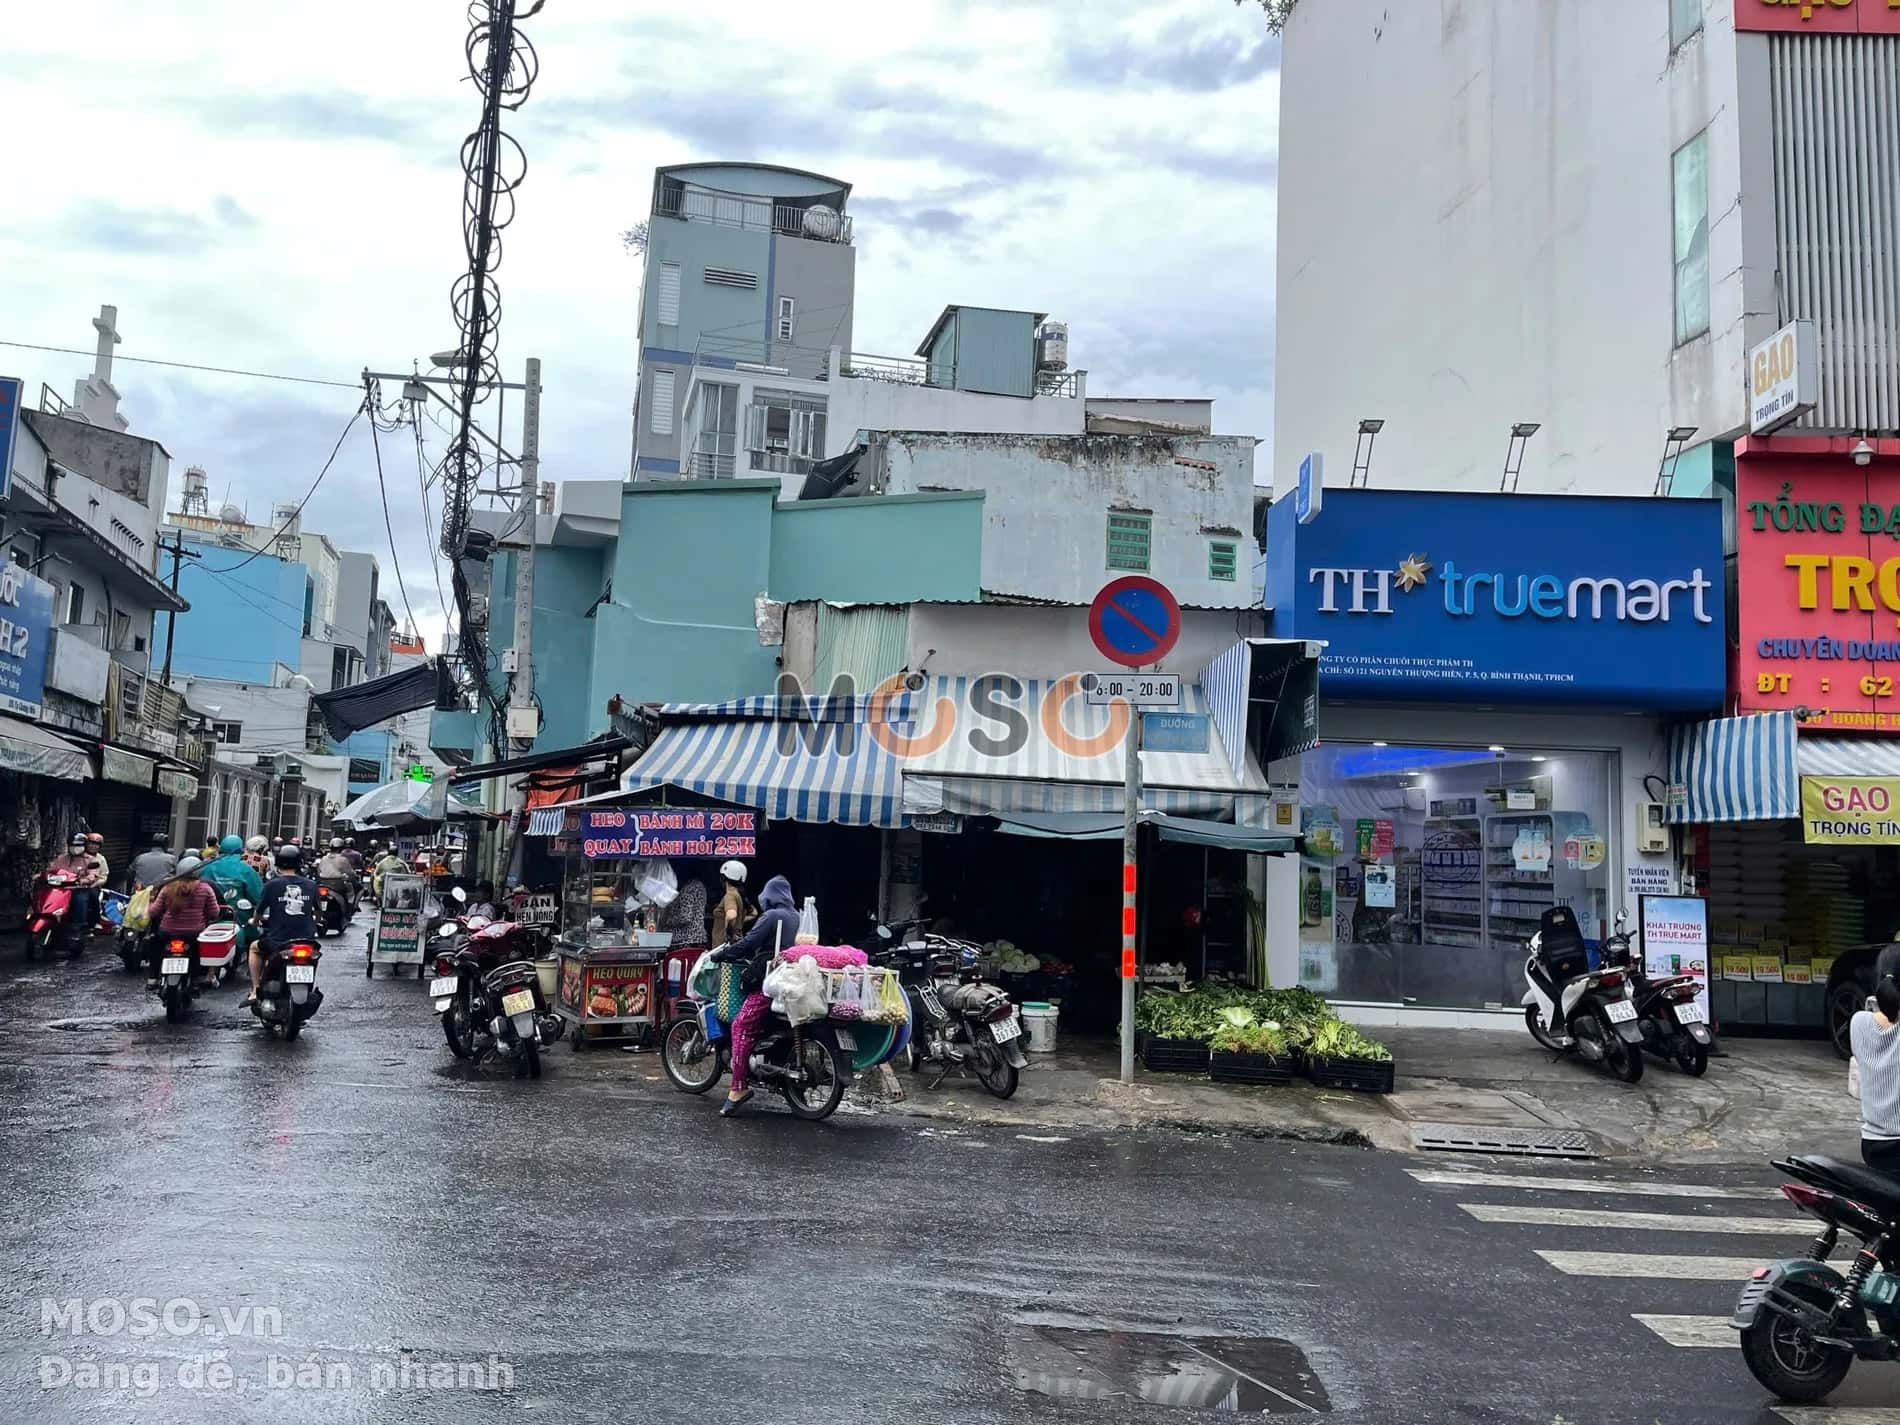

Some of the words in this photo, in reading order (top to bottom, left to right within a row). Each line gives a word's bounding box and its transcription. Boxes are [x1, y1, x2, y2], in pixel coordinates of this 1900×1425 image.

[1754, 333, 1794, 396] GẠO
[1747, 481, 1846, 533] TỔNG
[1310, 567, 1395, 613] TH
[1439, 560, 1712, 624] truemart
[1758, 635, 1843, 660] CHUYÊN
[1334, 655, 1344, 663] TY
[1462, 659, 1473, 667] TH
[1356, 667, 1368, 675] 121
[1544, 673, 1574, 682] TPHCM
[1757, 672, 1792, 693] ĐT
[1859, 675, 1893, 696] 62
[1139, 682, 1173, 696] 20:00
[1823, 786, 1890, 817] GẠO
[590, 812, 625, 827] HEO
[640, 812, 683, 830] BÁNH
[710, 812, 755, 830] 20K
[1810, 820, 1872, 838] TRỌNG
[584, 838, 634, 857] QUAY
[640, 837, 683, 855] BÁNH
[714, 836, 755, 855] 25K
